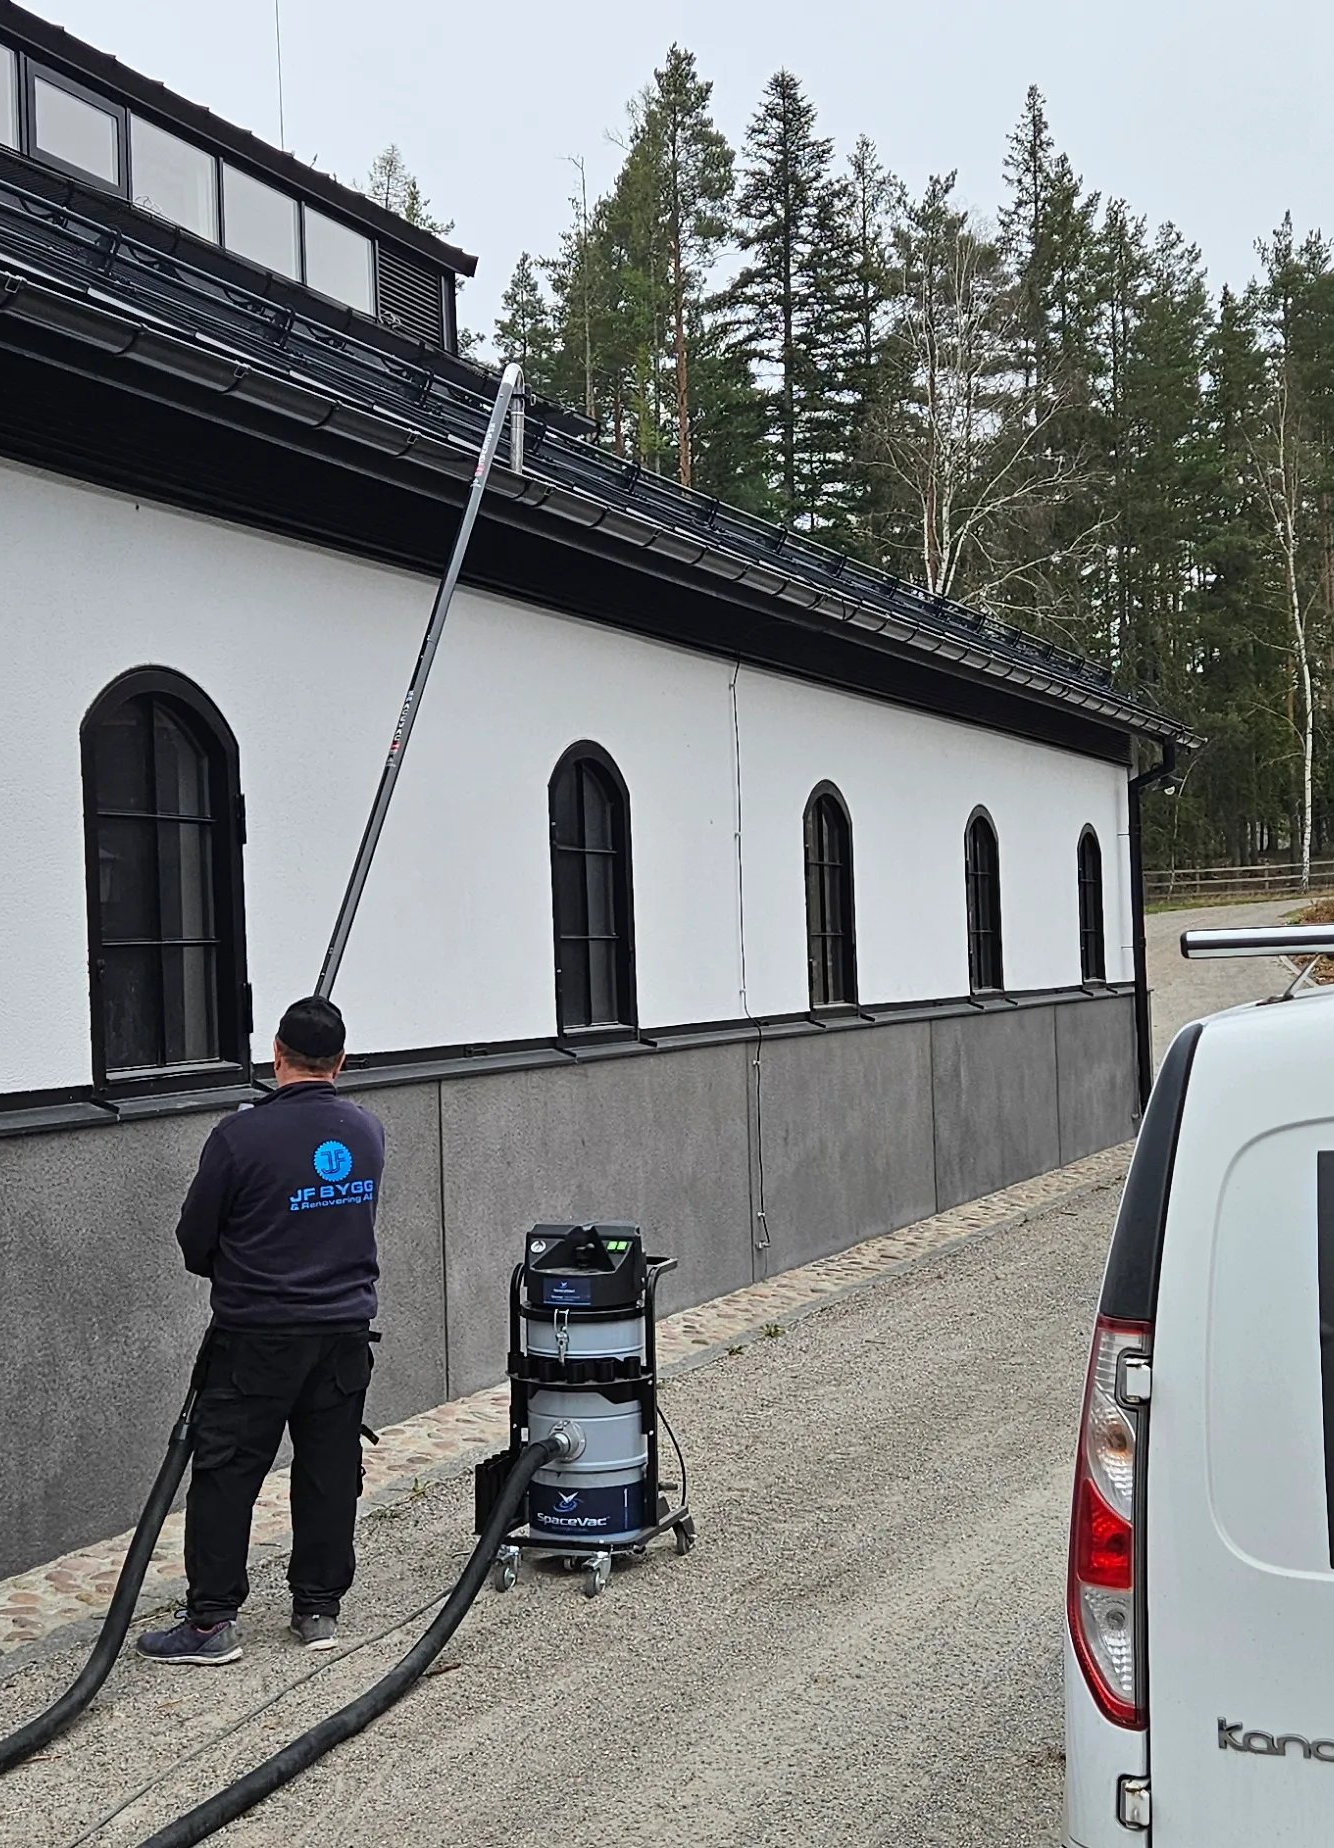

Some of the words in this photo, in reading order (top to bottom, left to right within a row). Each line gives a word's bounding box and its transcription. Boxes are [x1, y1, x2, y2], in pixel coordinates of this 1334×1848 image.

[289, 1187, 316, 1202] JF
[319, 1180, 374, 1199] BYGG
[290, 1203, 300, 1211] &
[301, 1196, 362, 1210] Renovering
[536, 1512, 607, 1526] SpaceVac
